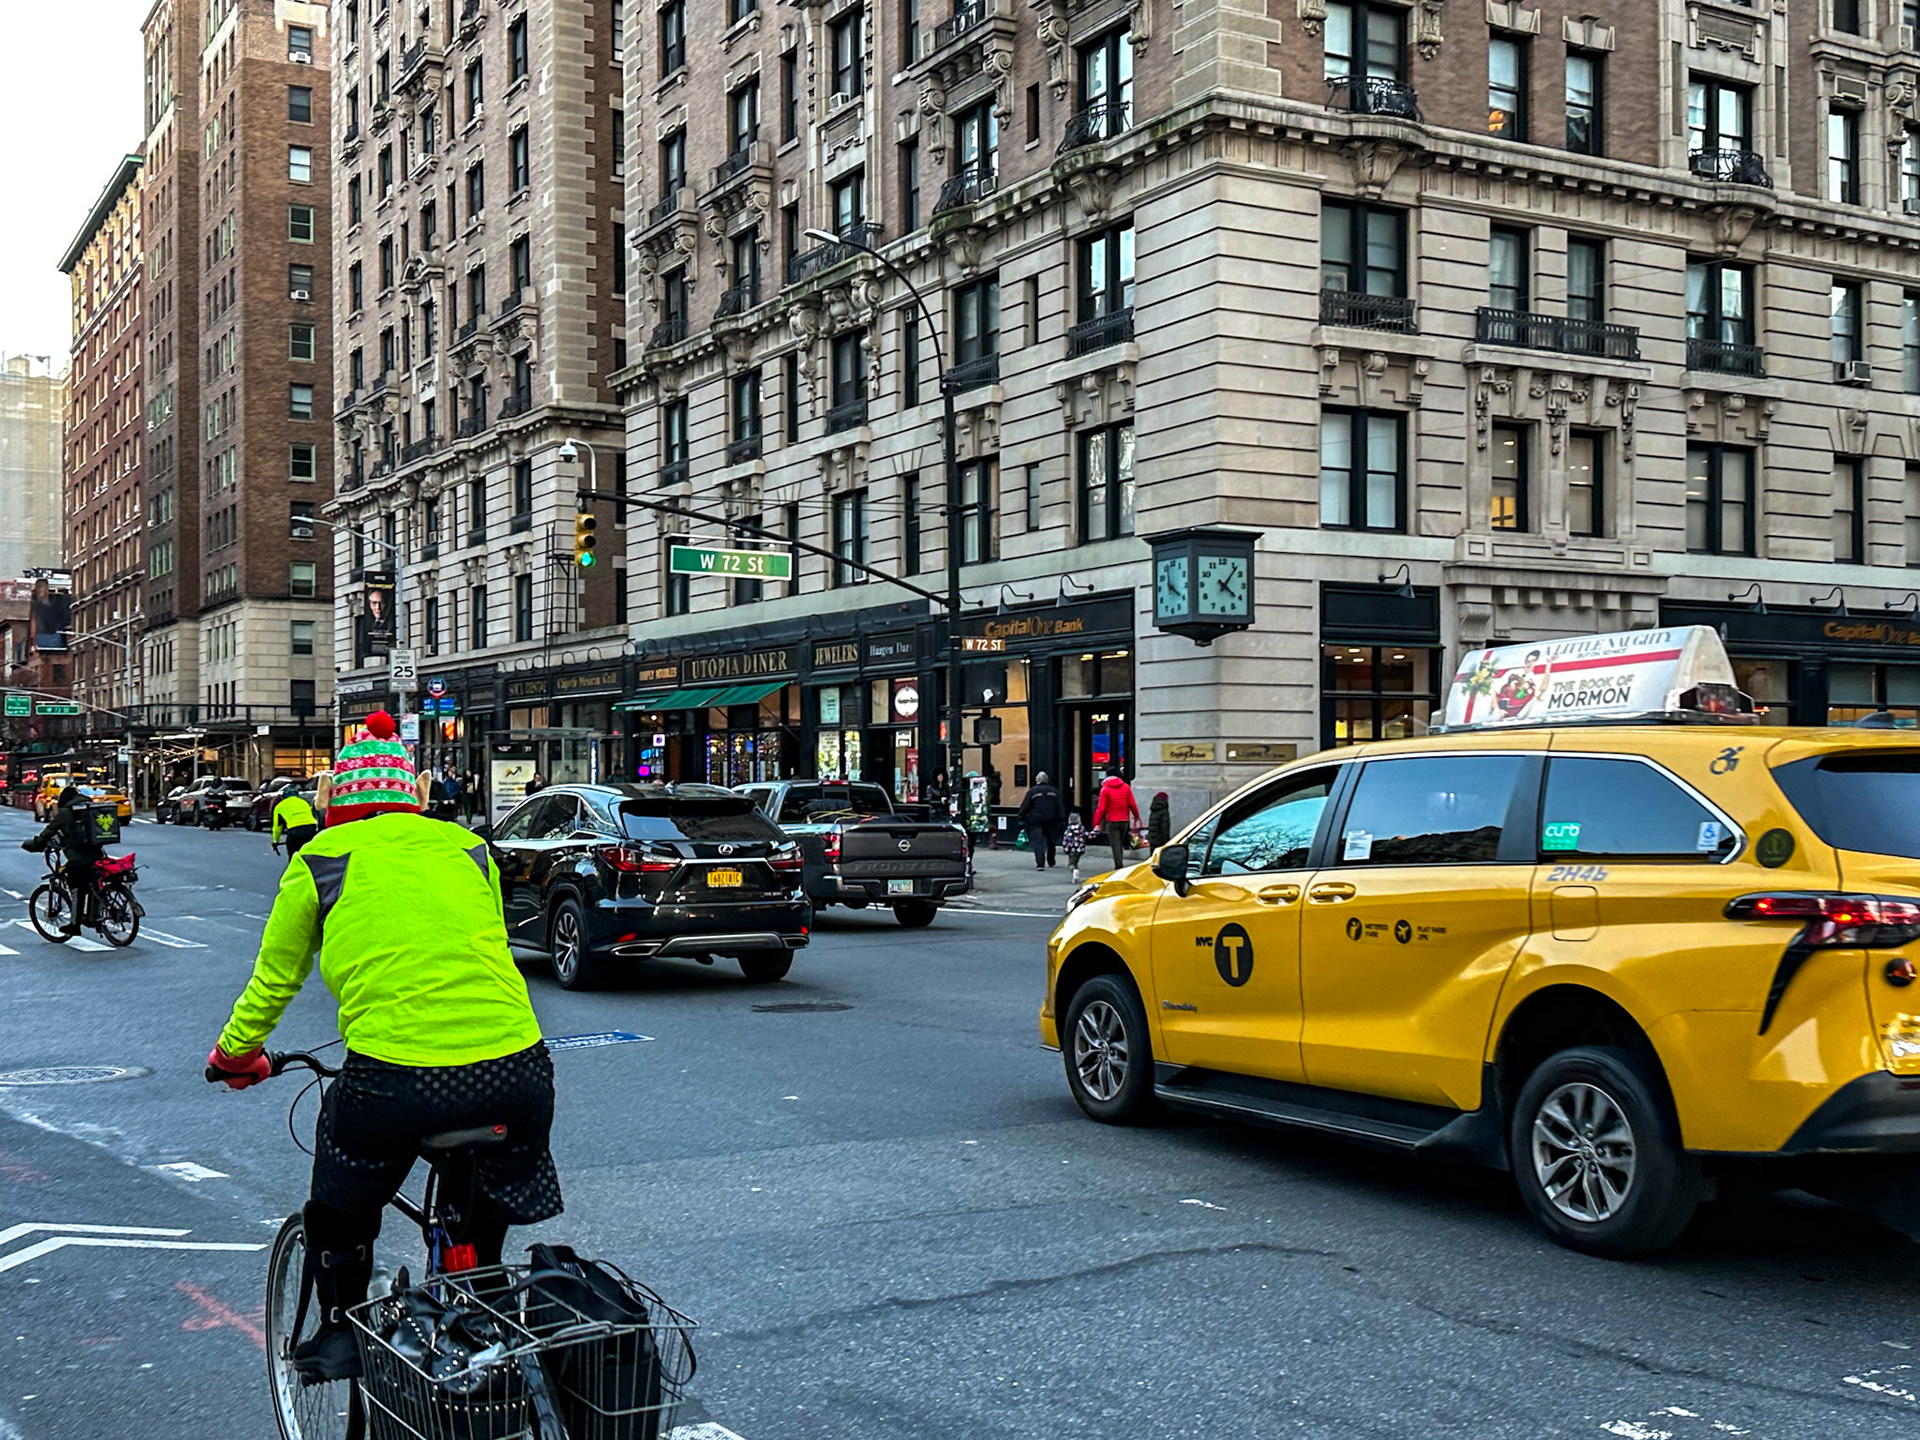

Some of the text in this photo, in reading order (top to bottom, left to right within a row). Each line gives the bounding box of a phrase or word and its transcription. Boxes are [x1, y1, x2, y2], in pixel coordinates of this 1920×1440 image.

[700, 553, 764, 573] W 72 St
[1054, 618, 1083, 634] Bank
[965, 639, 1002, 650] W 72 ST
[815, 643, 858, 666] JEWELERS
[393, 665, 414, 678] 25
[692, 651, 787, 680] UTOPIA DINER
[1553, 674, 1635, 693] THE BOOK OF
[1547, 686, 1632, 710] MORMON
[1545, 823, 1580, 837] curb
[1195, 936, 1213, 947] NYC
[1222, 936, 1244, 979] T
